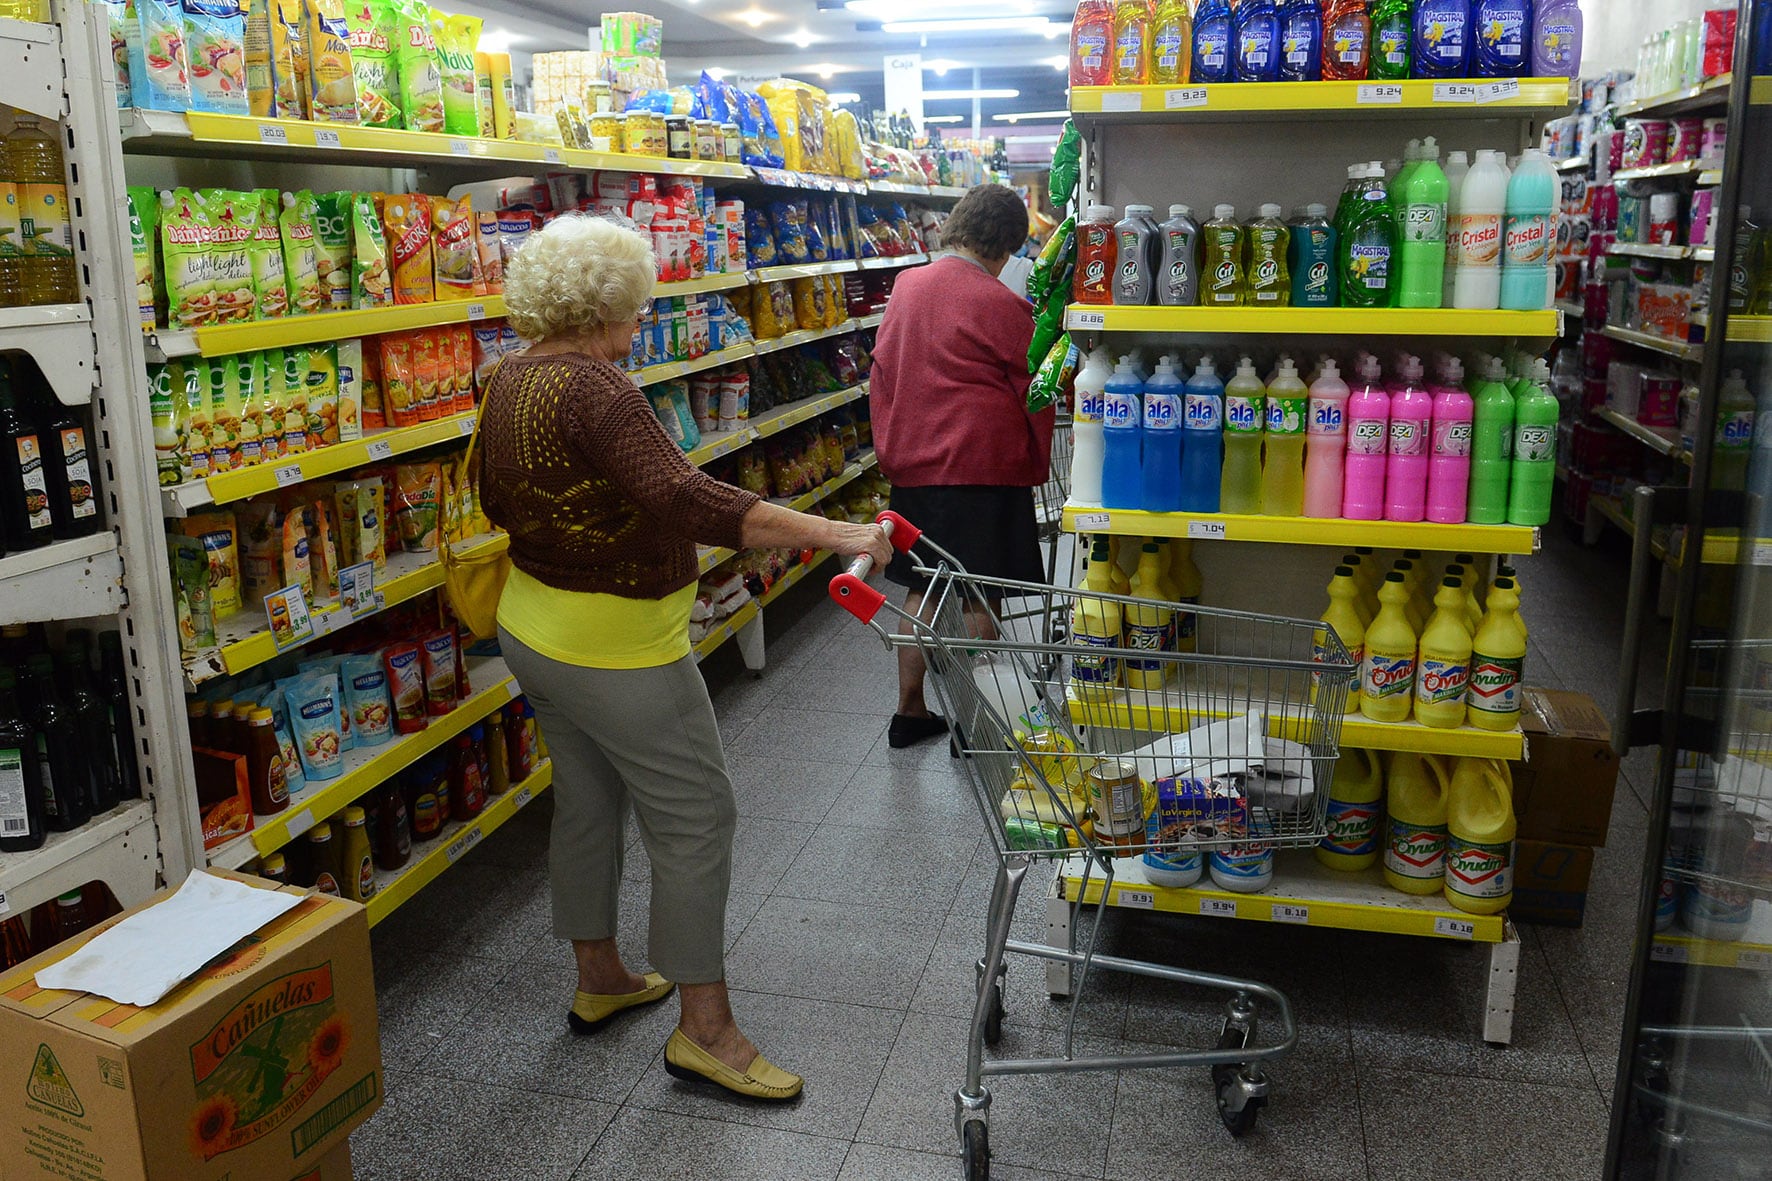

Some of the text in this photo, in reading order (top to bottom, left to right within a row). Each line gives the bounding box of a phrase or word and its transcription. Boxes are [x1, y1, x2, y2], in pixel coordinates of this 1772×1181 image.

[1423, 12, 1466, 23] MAGISTRAL
[1482, 10, 1524, 23] MAGISTRAL
[891, 58, 914, 70] Caja
[1182, 90, 1207, 100] 9.23
[1376, 87, 1402, 96] 9.24
[1449, 86, 1475, 95] 9.24
[1408, 208, 1435, 224] DEA
[1462, 224, 1498, 246] Cristal
[1506, 222, 1544, 247] Cristal
[1352, 244, 1390, 258] MAGISTRAL
[214, 252, 246, 276] light
[1088, 262, 1103, 276] Cif
[1122, 262, 1137, 275] Cif
[1170, 262, 1185, 275] Cif
[1216, 262, 1234, 278] Cif
[1258, 262, 1276, 276] Cif
[1310, 263, 1327, 279] Cif
[1082, 398, 1104, 415] ala
[1106, 400, 1129, 419] ala
[1148, 400, 1172, 420] ala
[1188, 401, 1212, 420] ala
[1230, 404, 1254, 422] ala
[1316, 406, 1342, 424] ala
[1356, 426, 1383, 438] DEA
[1522, 430, 1549, 444] DEA
[1088, 514, 1110, 523] 7.13
[1202, 524, 1225, 532] 7.04
[1130, 635, 1158, 648] DEA
[1451, 852, 1502, 872] Ayudín
[1212, 902, 1235, 912] 9.94
[1450, 923, 1474, 934] 8.18
[212, 979, 316, 1059] Cañuelas
[253, 1090, 305, 1138] SUNFLOWER
[306, 1074, 321, 1092] OIL
